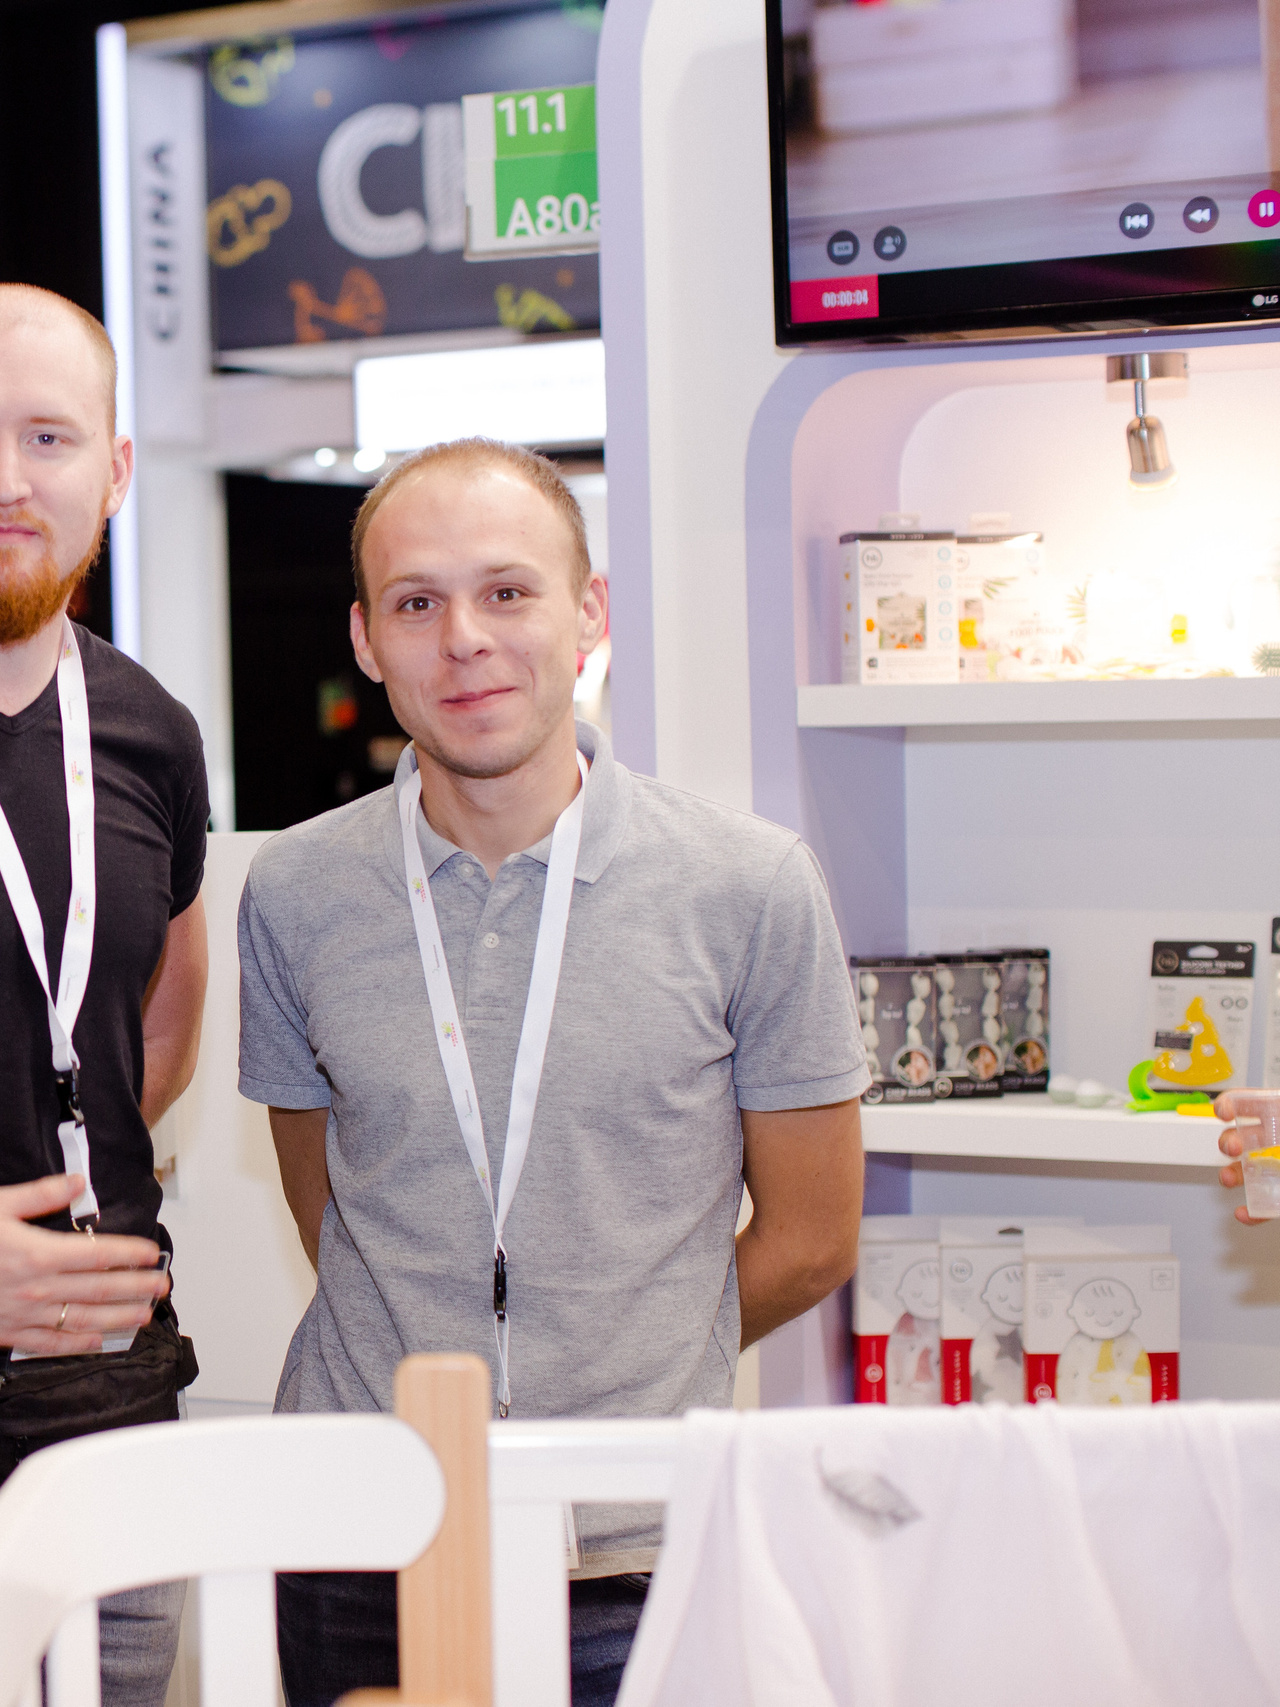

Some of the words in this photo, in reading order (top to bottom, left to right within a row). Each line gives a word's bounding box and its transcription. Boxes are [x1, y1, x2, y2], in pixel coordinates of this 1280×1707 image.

[496, 92, 567, 137] 11.1
[822, 288, 869, 308] 00:00:04
[1265, 294, 1279, 304] LG
